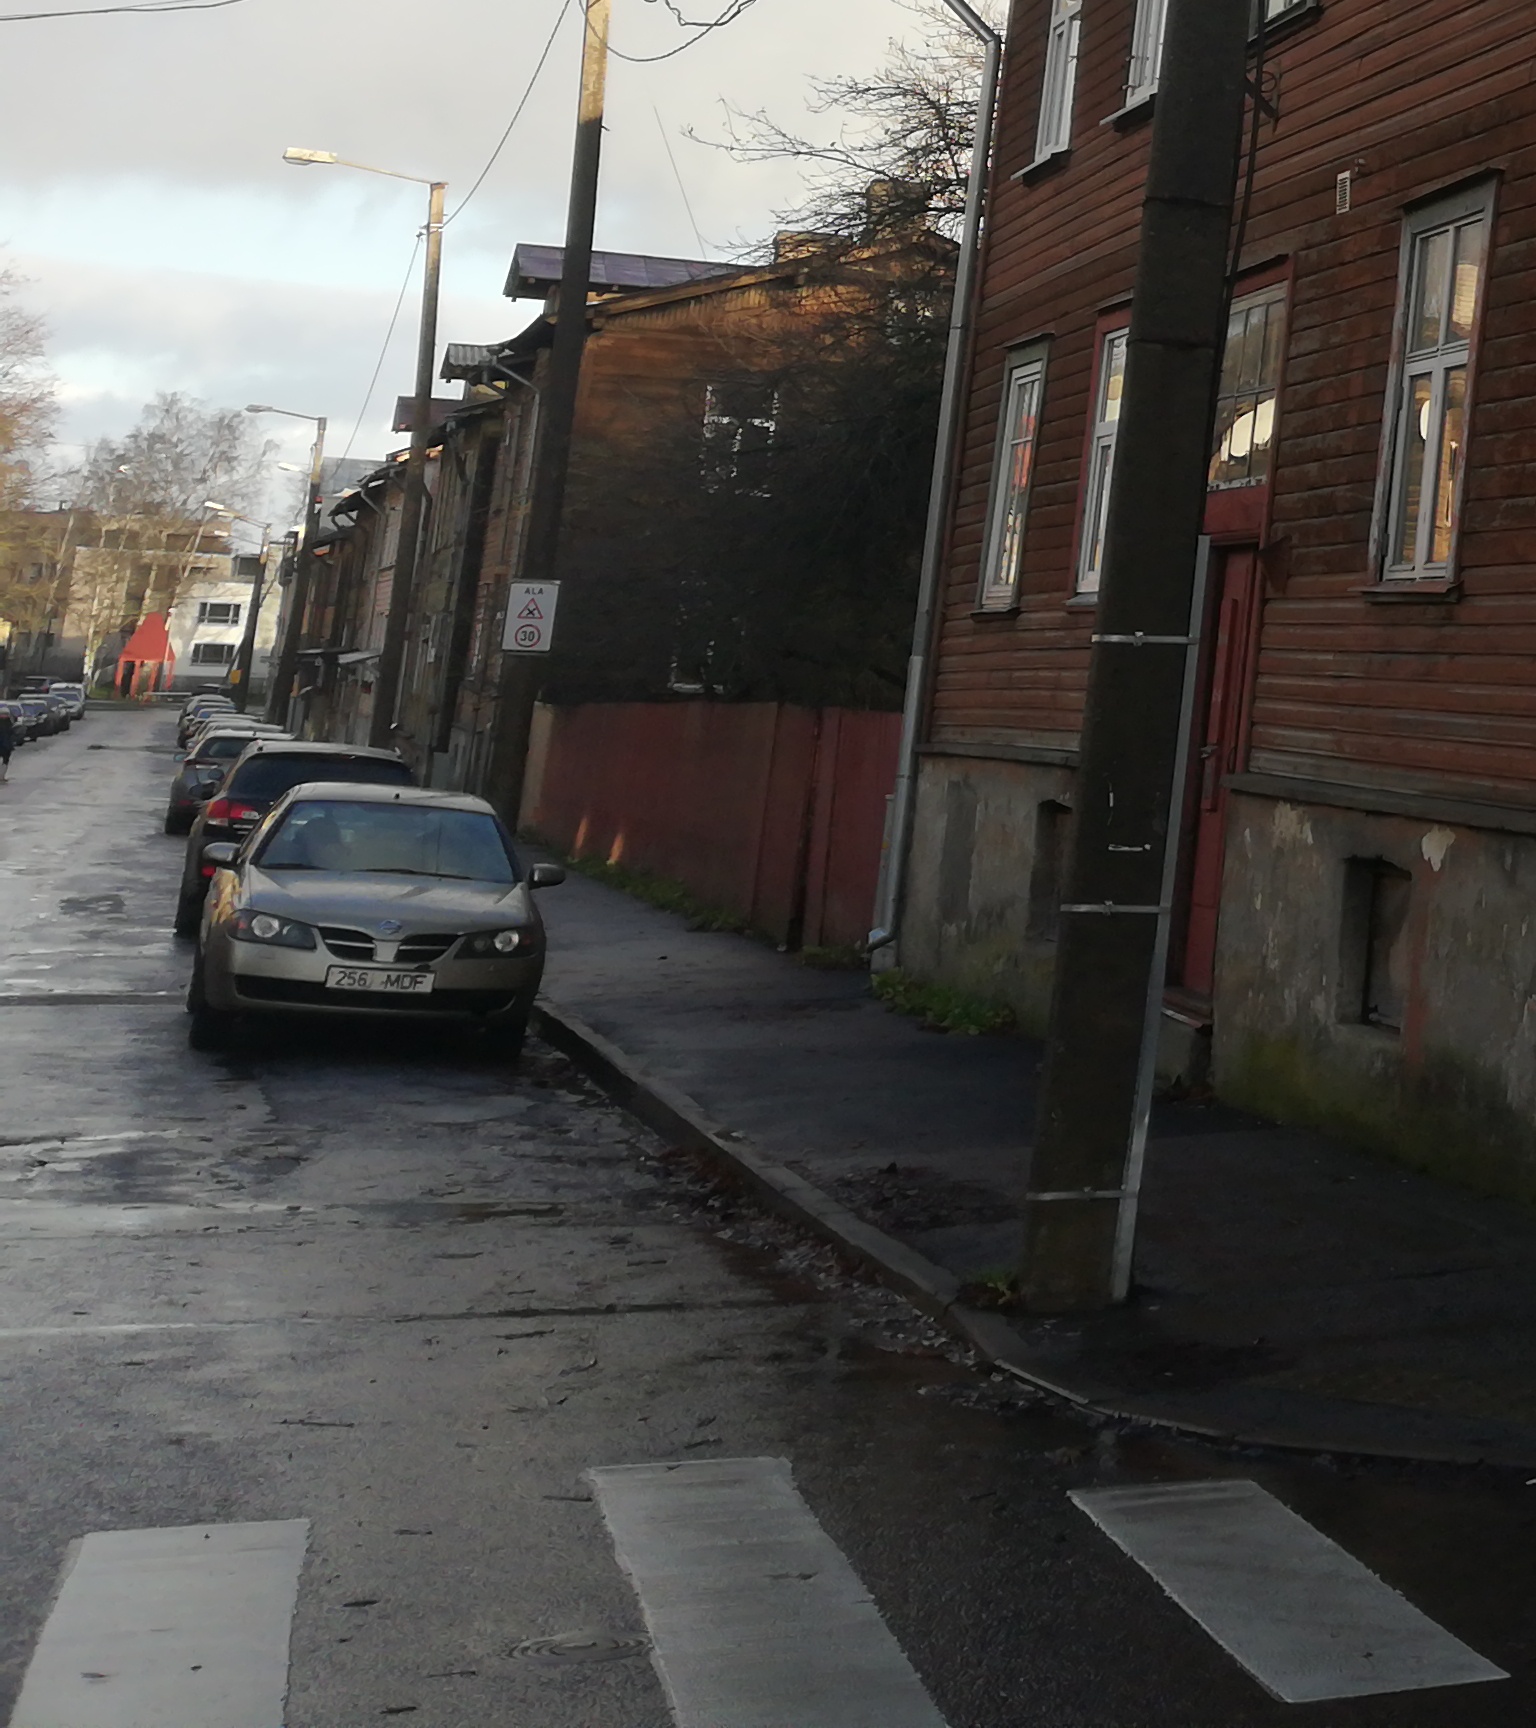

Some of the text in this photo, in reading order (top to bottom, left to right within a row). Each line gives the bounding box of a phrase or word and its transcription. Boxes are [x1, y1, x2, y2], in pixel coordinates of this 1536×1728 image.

[524, 587, 544, 595] ALA
[520, 630, 535, 642] 30
[335, 970, 428, 991] 256 MDF
